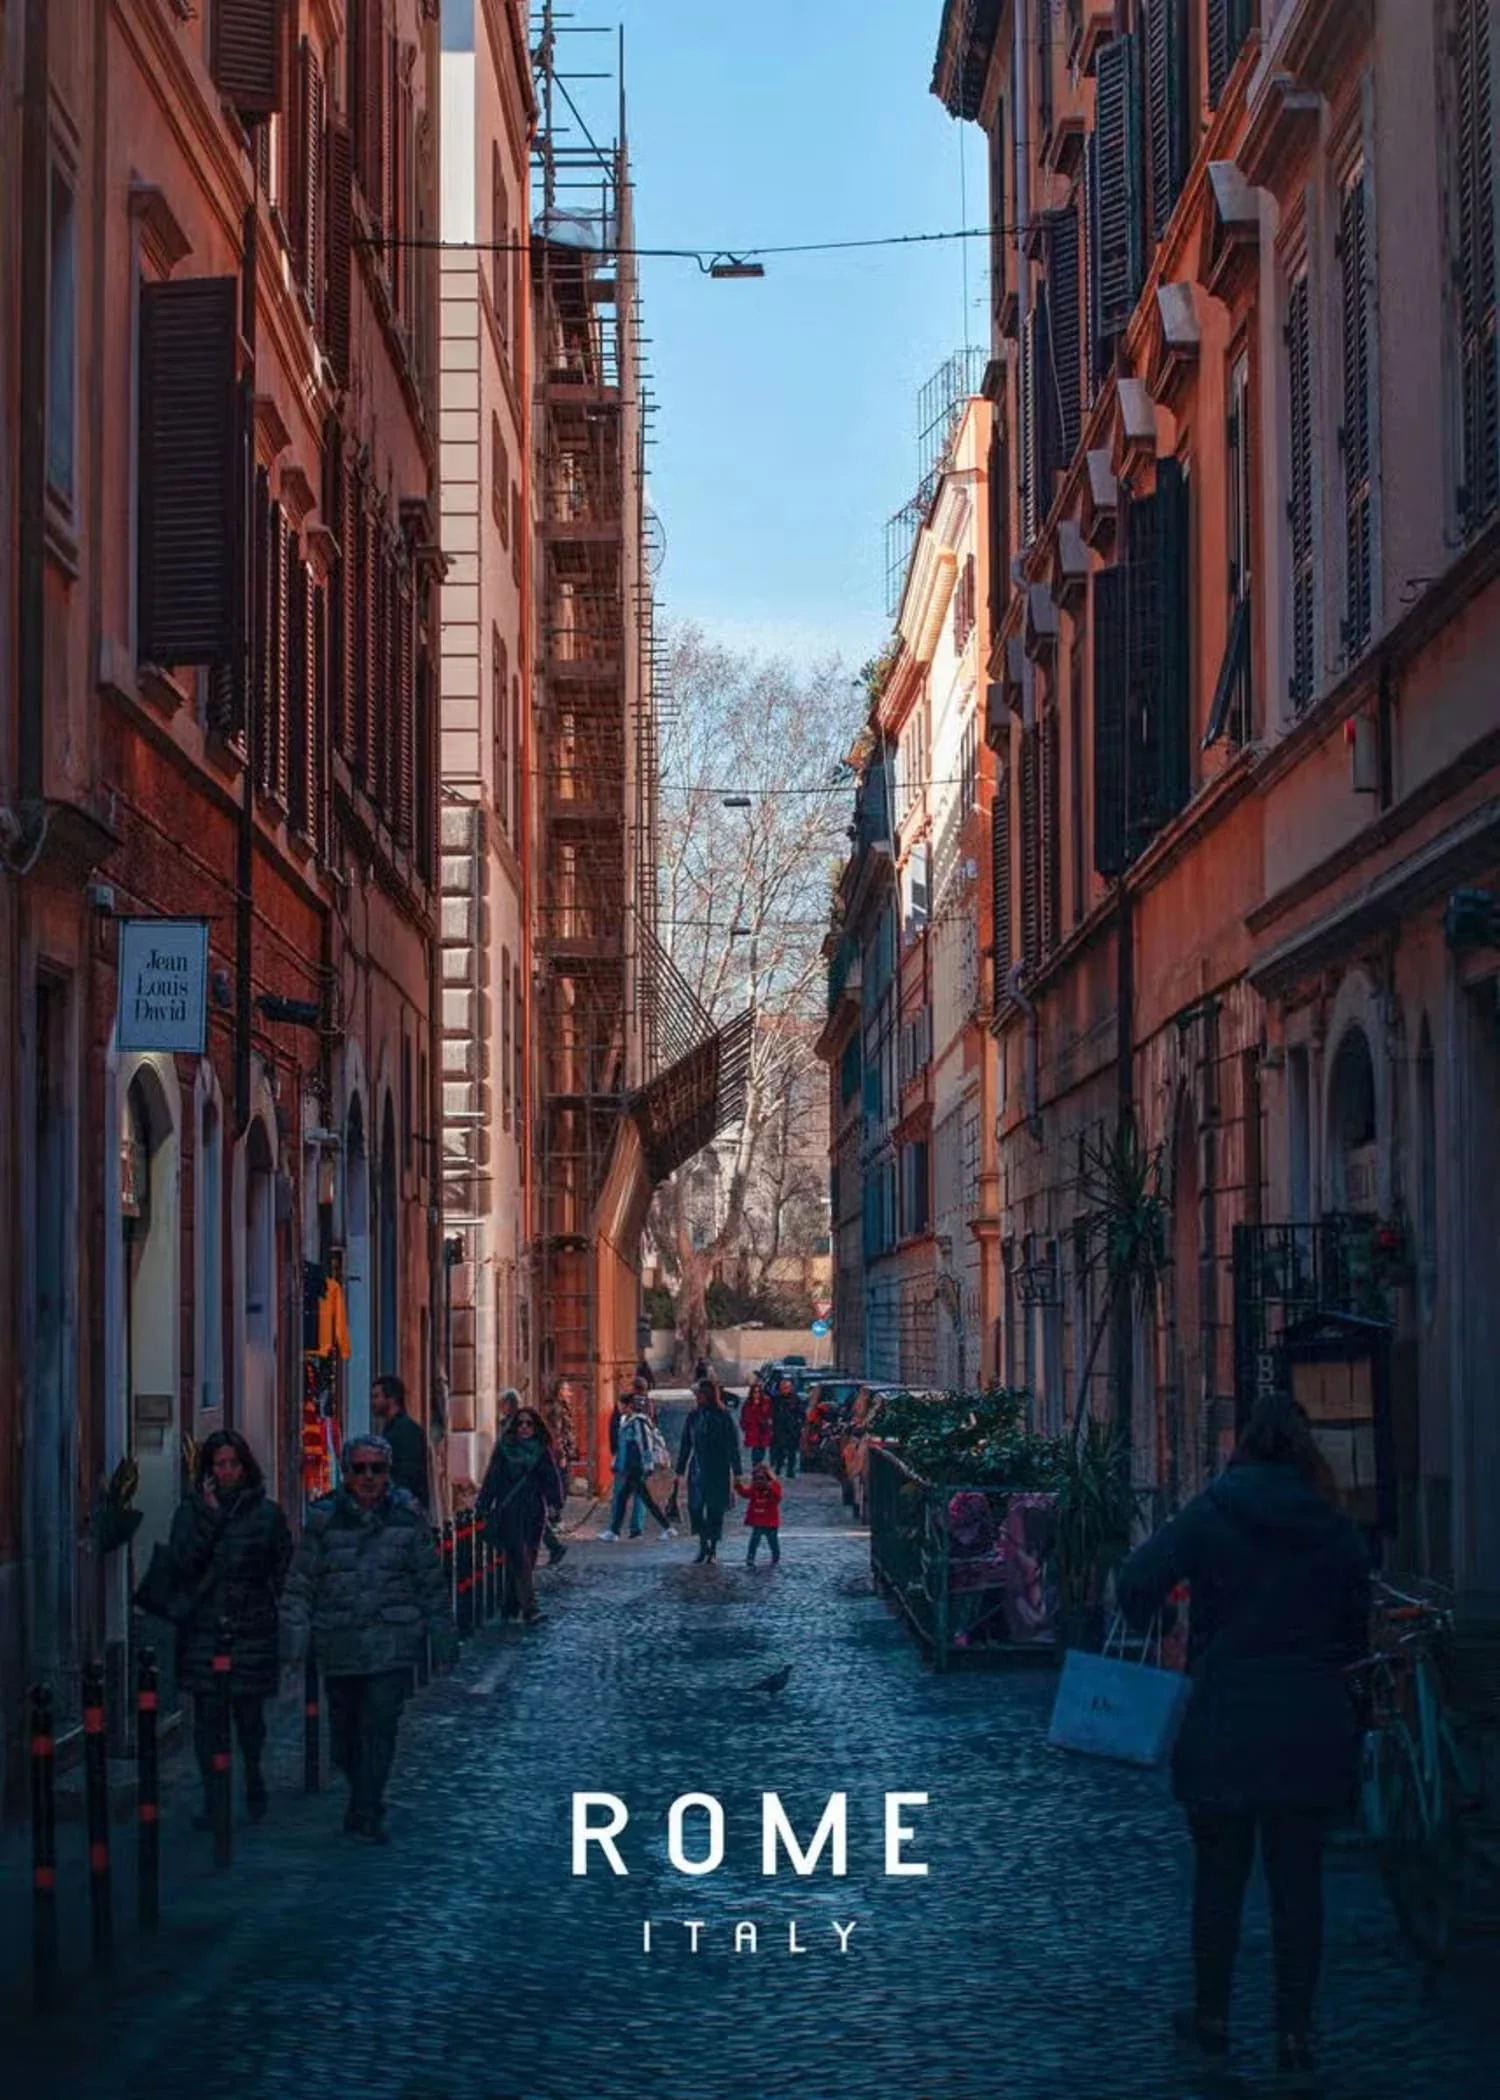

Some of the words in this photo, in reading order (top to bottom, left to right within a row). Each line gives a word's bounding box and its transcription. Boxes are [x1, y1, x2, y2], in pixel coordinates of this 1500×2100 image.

[146, 949, 188, 972] Jean
[137, 972, 189, 997] Louis
[135, 999, 186, 1021] David
